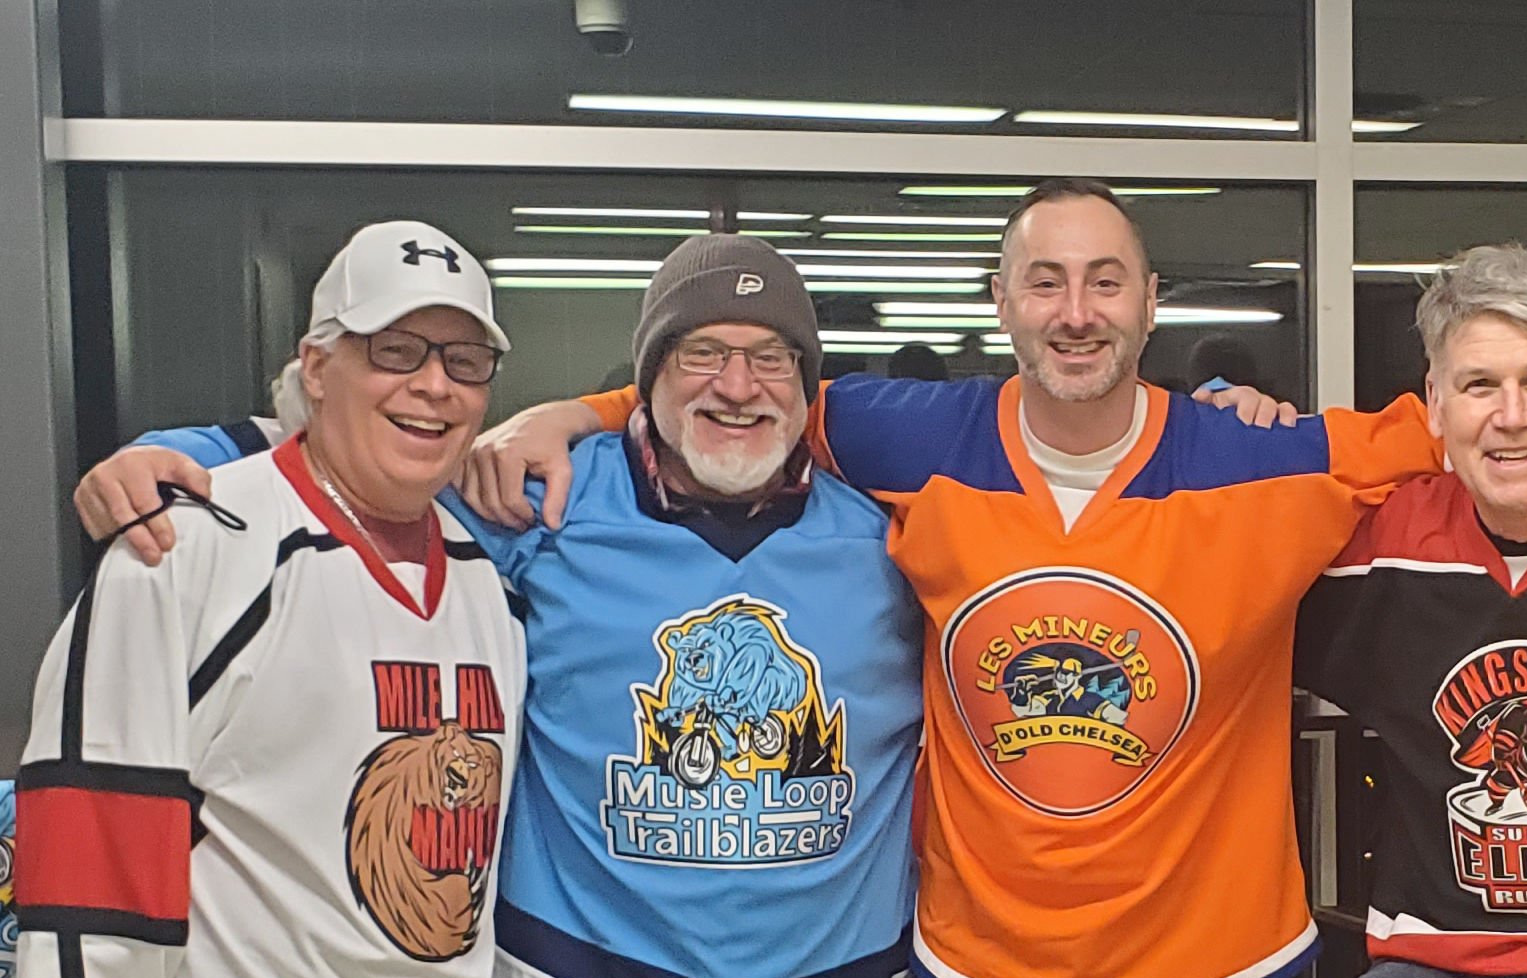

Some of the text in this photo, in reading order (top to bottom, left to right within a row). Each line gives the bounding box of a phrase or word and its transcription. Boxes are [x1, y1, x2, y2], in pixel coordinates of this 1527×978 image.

[976, 616, 1157, 701] LES MINEURS
[374, 663, 441, 729] MILE
[999, 723, 1143, 756] D'OLD CHELSEA
[616, 770, 848, 815] Musie Loop
[619, 810, 844, 858] Trailblazers
